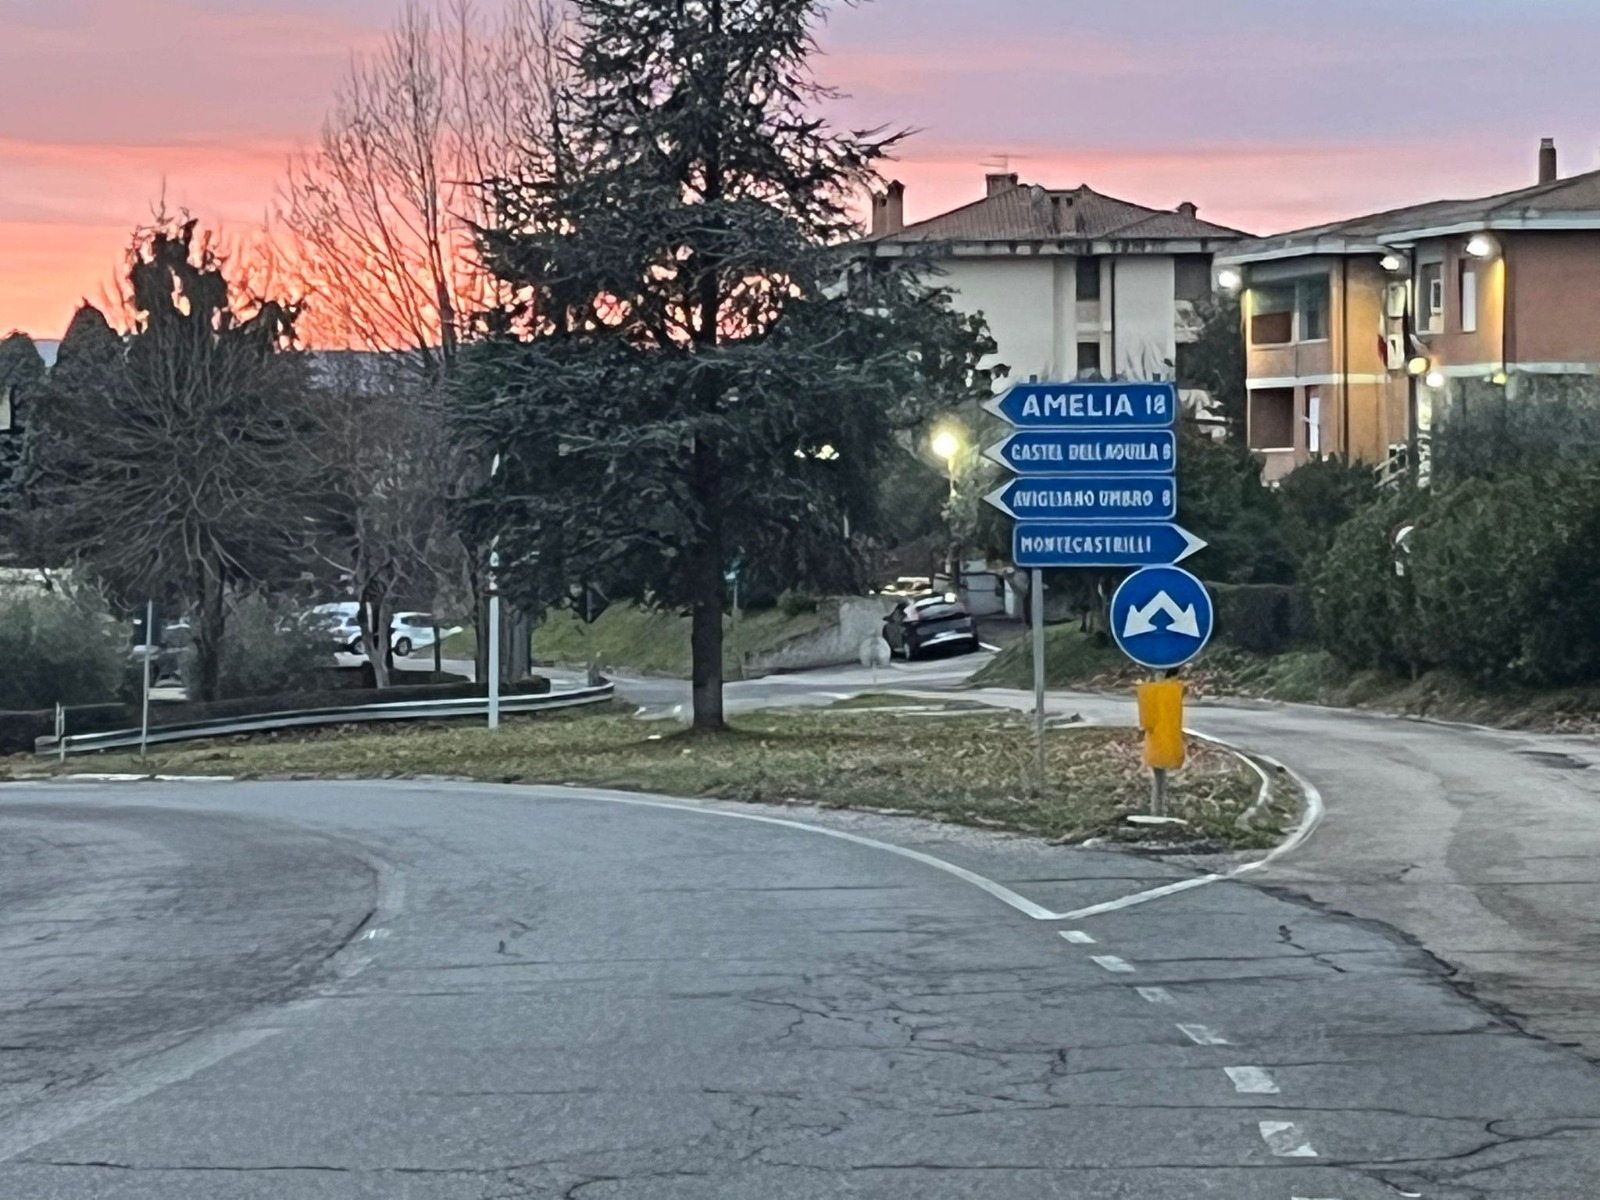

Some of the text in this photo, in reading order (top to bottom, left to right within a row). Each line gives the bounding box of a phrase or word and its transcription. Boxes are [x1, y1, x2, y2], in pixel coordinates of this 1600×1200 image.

[1022, 394, 1166, 416] AMELIA 18
[1011, 443, 1063, 460] CASTEL
[1013, 490, 1095, 507] AVIGLIANO
[1099, 490, 1153, 507] UMBRO
[1021, 535, 1151, 553] MONTECASTRILLI
